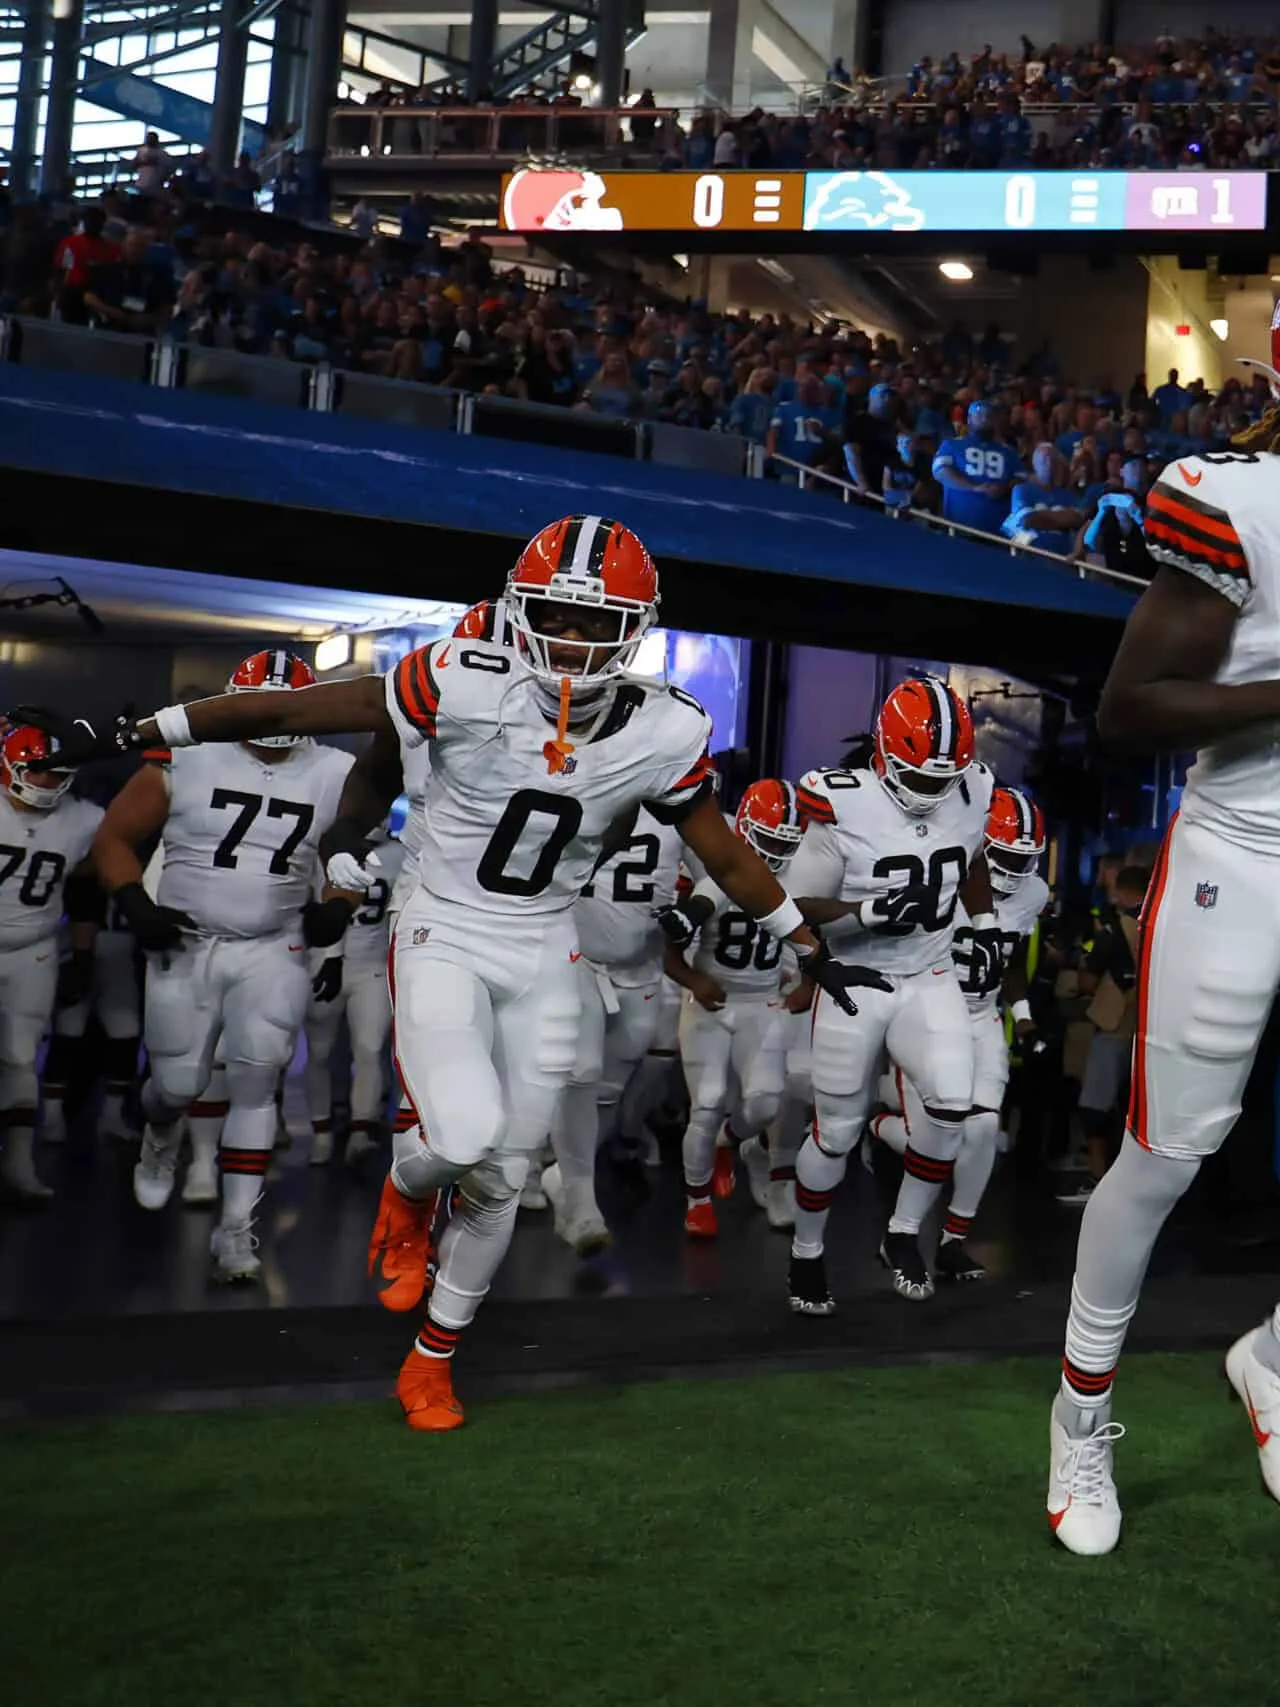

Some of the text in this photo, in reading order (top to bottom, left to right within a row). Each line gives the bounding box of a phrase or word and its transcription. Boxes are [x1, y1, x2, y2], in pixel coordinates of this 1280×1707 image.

[693, 175, 724, 227] 0
[1005, 175, 1036, 227] 0
[1210, 178, 1234, 224] 1
[964, 447, 1005, 479] 99
[460, 650, 510, 674] 0
[210, 788, 315, 876] 77
[477, 788, 583, 896] 0
[580, 833, 660, 902] 2
